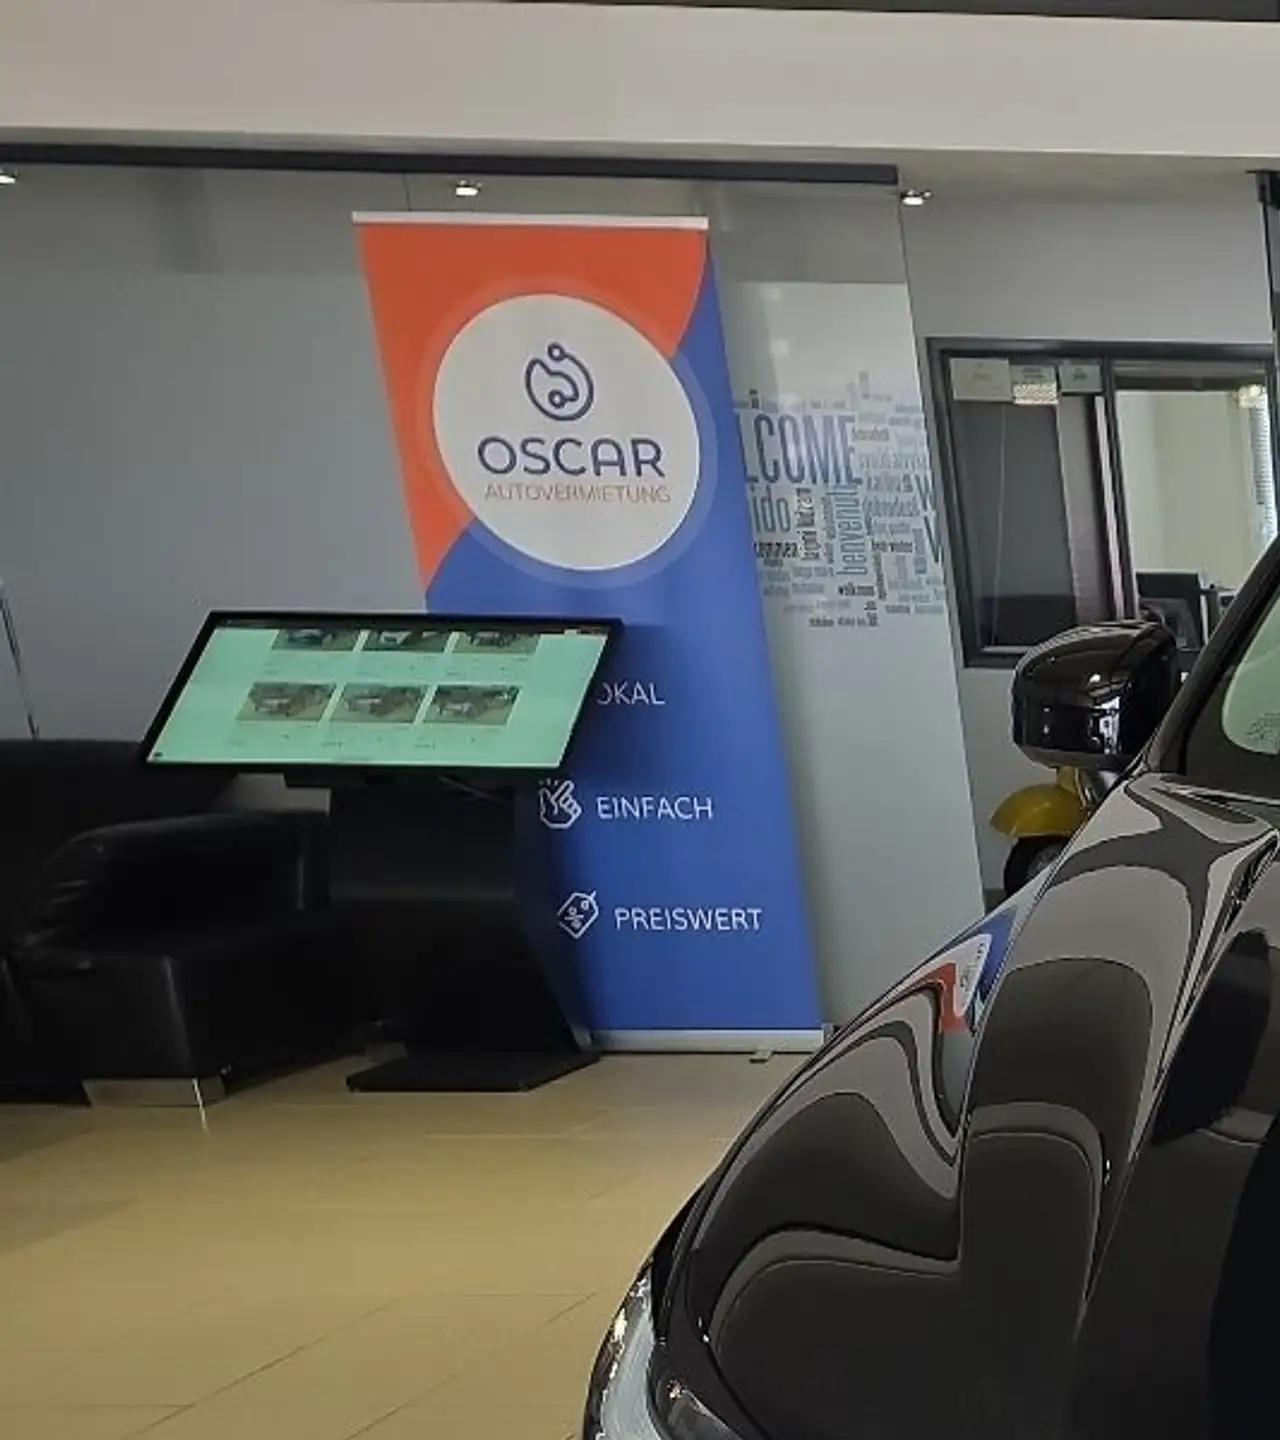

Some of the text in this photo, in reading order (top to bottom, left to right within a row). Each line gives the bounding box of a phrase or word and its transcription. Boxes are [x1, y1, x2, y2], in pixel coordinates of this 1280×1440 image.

[477, 435, 666, 478] OSCAR
[484, 482, 672, 503] AUTOVERMIETUNG
[596, 796, 714, 819] EINFACH
[614, 907, 763, 931] PREISWERT
